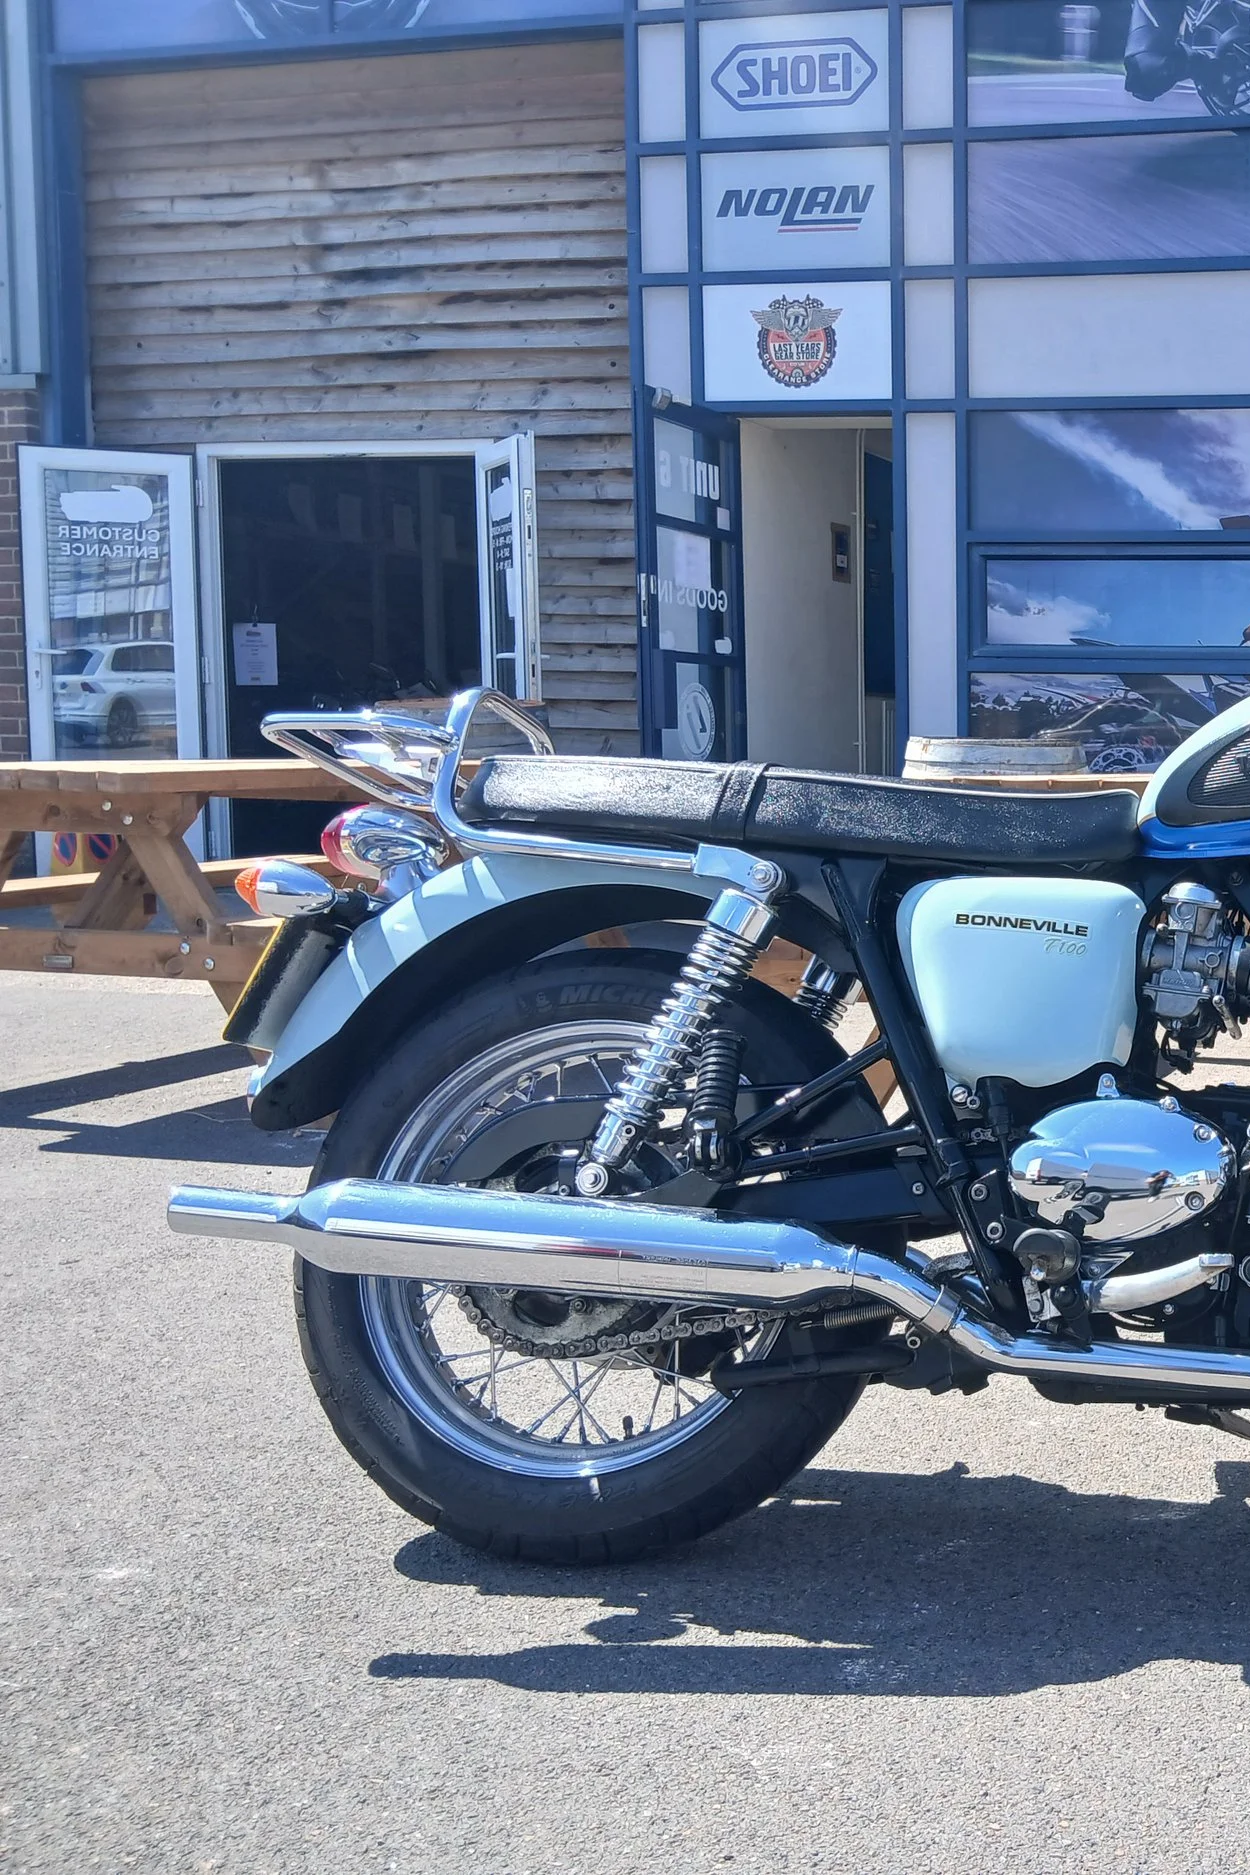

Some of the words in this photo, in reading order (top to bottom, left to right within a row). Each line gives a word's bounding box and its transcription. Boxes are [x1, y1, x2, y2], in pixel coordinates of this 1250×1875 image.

[736, 52, 852, 98] SHOEI
[716, 184, 875, 227] NOLAN
[773, 343, 793, 353] LAST
[796, 343, 821, 352] YEARS
[774, 352, 794, 361] GEAR
[796, 352, 820, 360] STORE
[763, 353, 808, 383] CLEARANCE
[810, 351, 831, 379] STORE
[955, 913, 1089, 937] BONNEVILLE
[1044, 937, 1088, 956] T100
[559, 984, 664, 1007] MICHE
